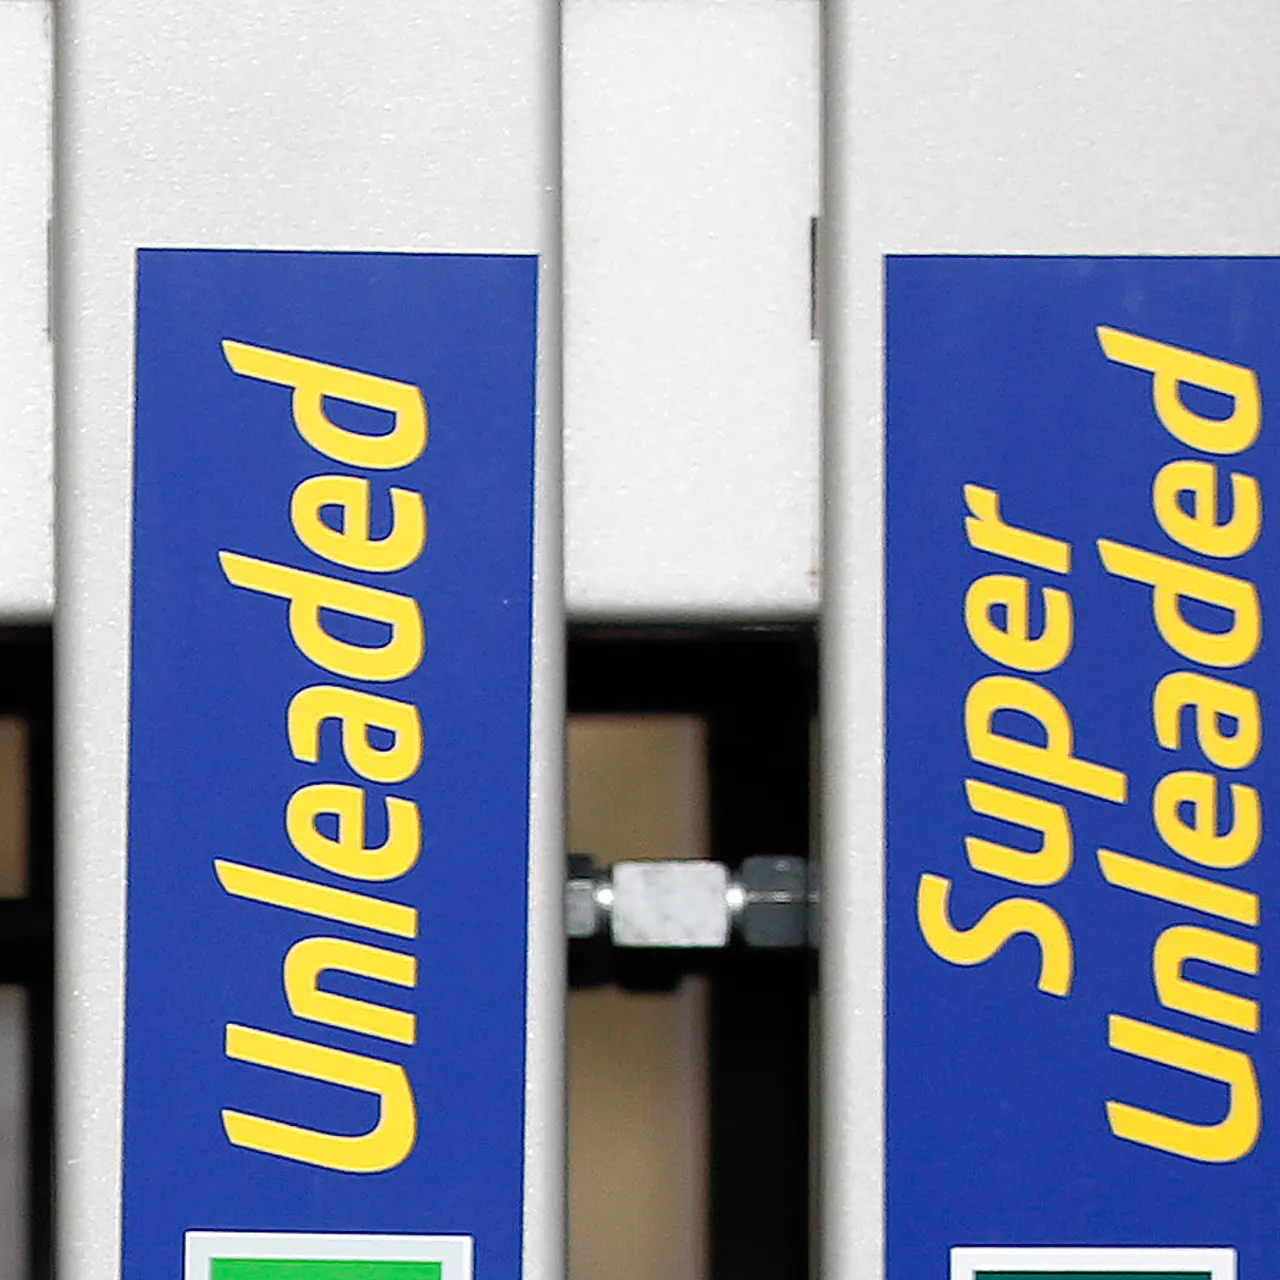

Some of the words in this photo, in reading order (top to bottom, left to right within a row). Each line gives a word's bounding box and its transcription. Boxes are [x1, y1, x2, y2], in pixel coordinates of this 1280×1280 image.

[212, 338, 429, 1175] Unleaded
[916, 482, 1128, 998] Super
[1095, 324, 1263, 1164] Unleaded
